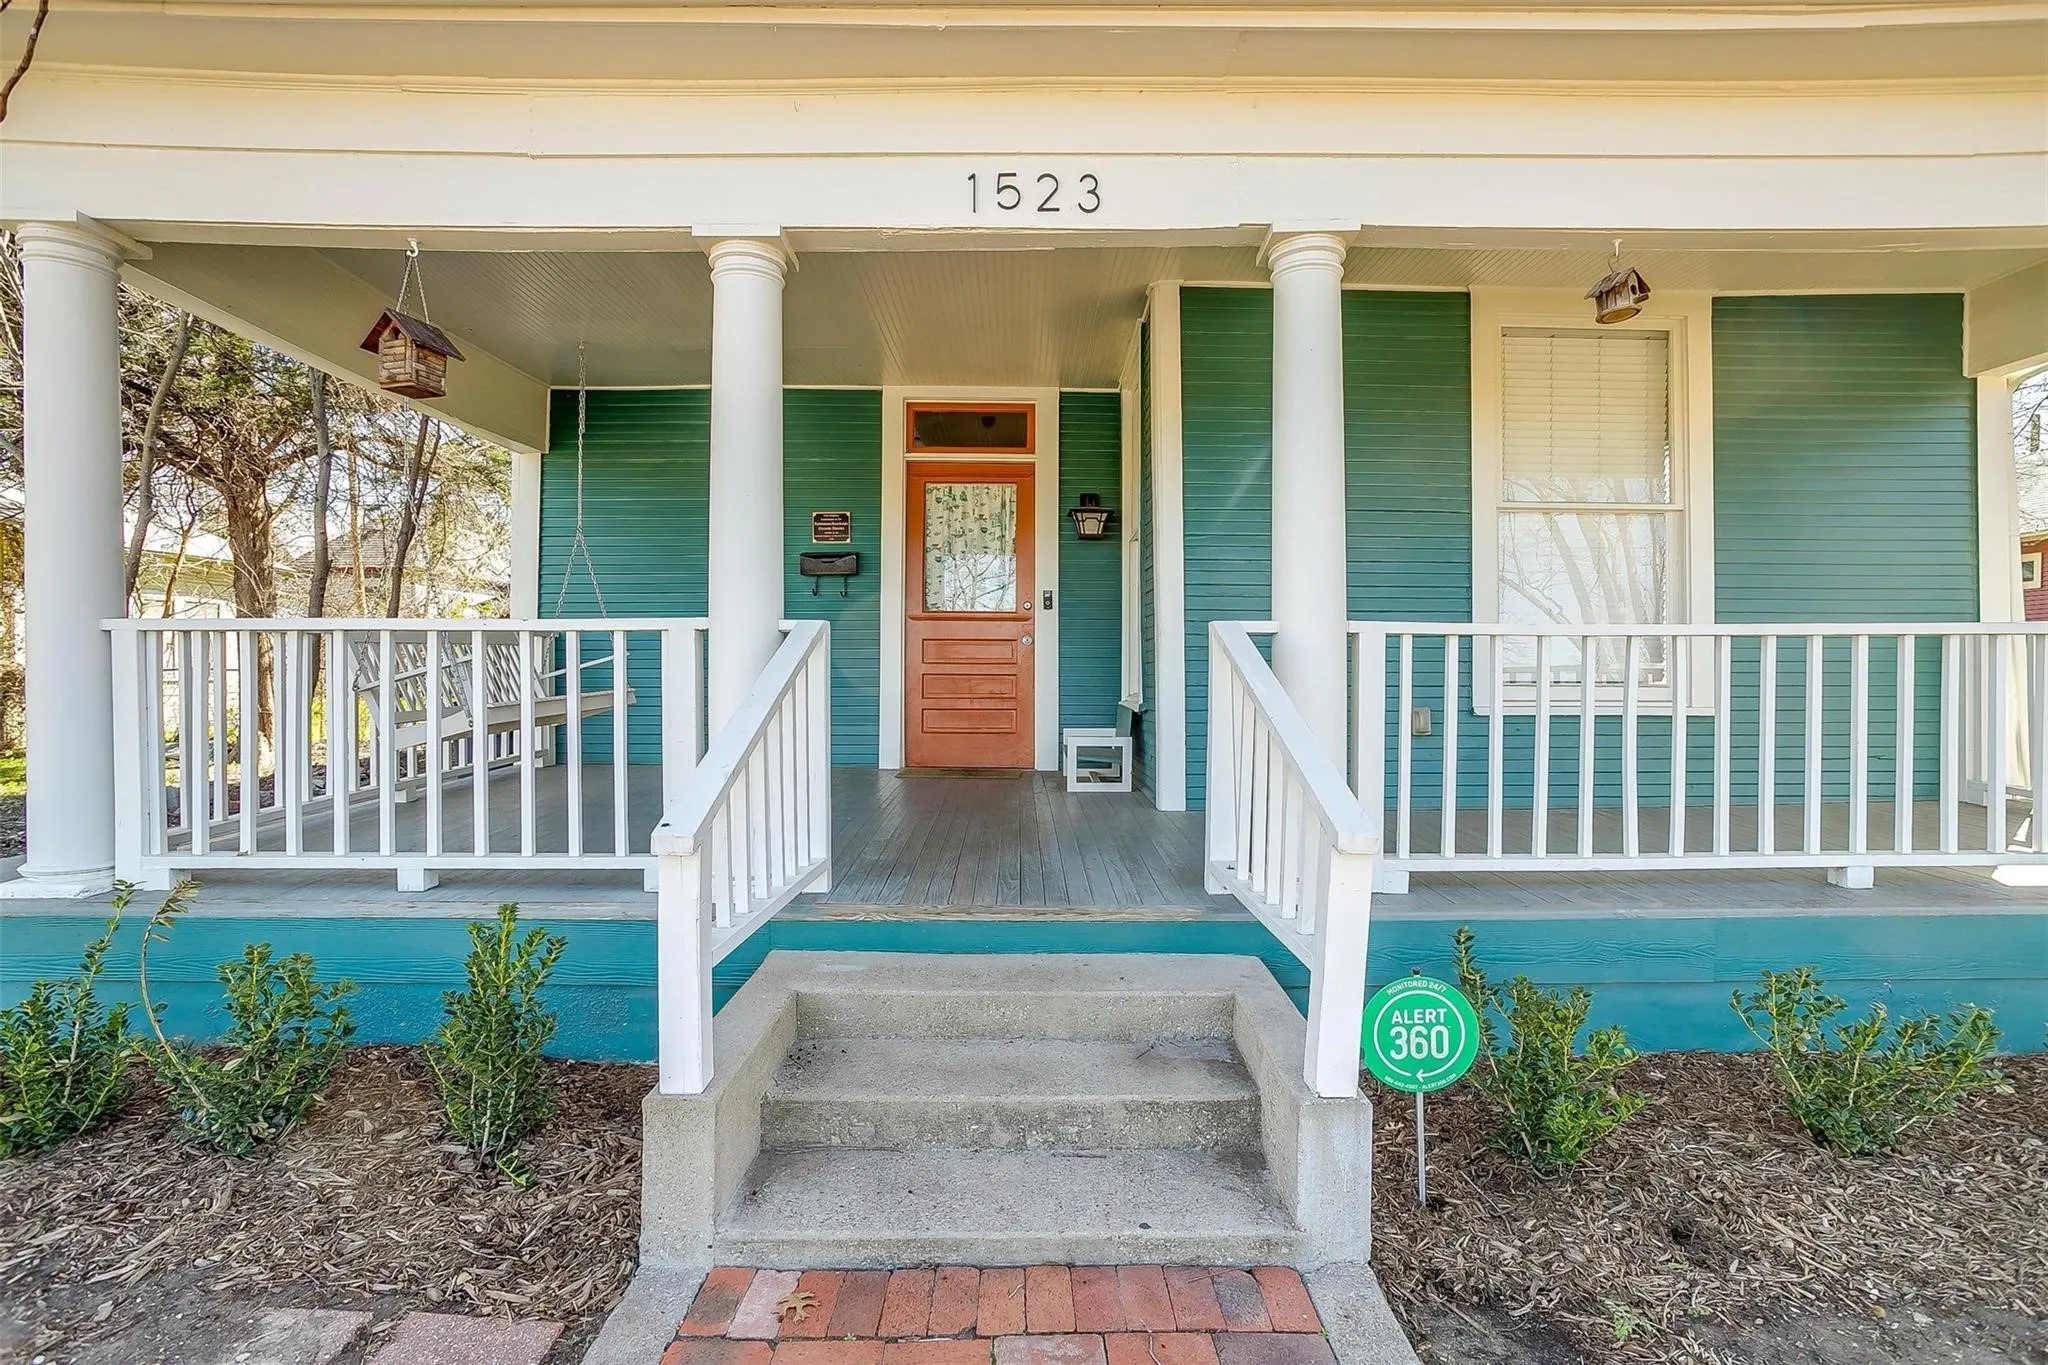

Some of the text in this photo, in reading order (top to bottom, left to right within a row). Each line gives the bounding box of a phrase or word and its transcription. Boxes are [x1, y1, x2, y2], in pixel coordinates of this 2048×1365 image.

[967, 172, 1101, 214] 1523
[1386, 980, 1447, 996] MONITORED 24/7
[1391, 1008, 1448, 1024] ALERT
[1389, 1025, 1450, 1060] 360
